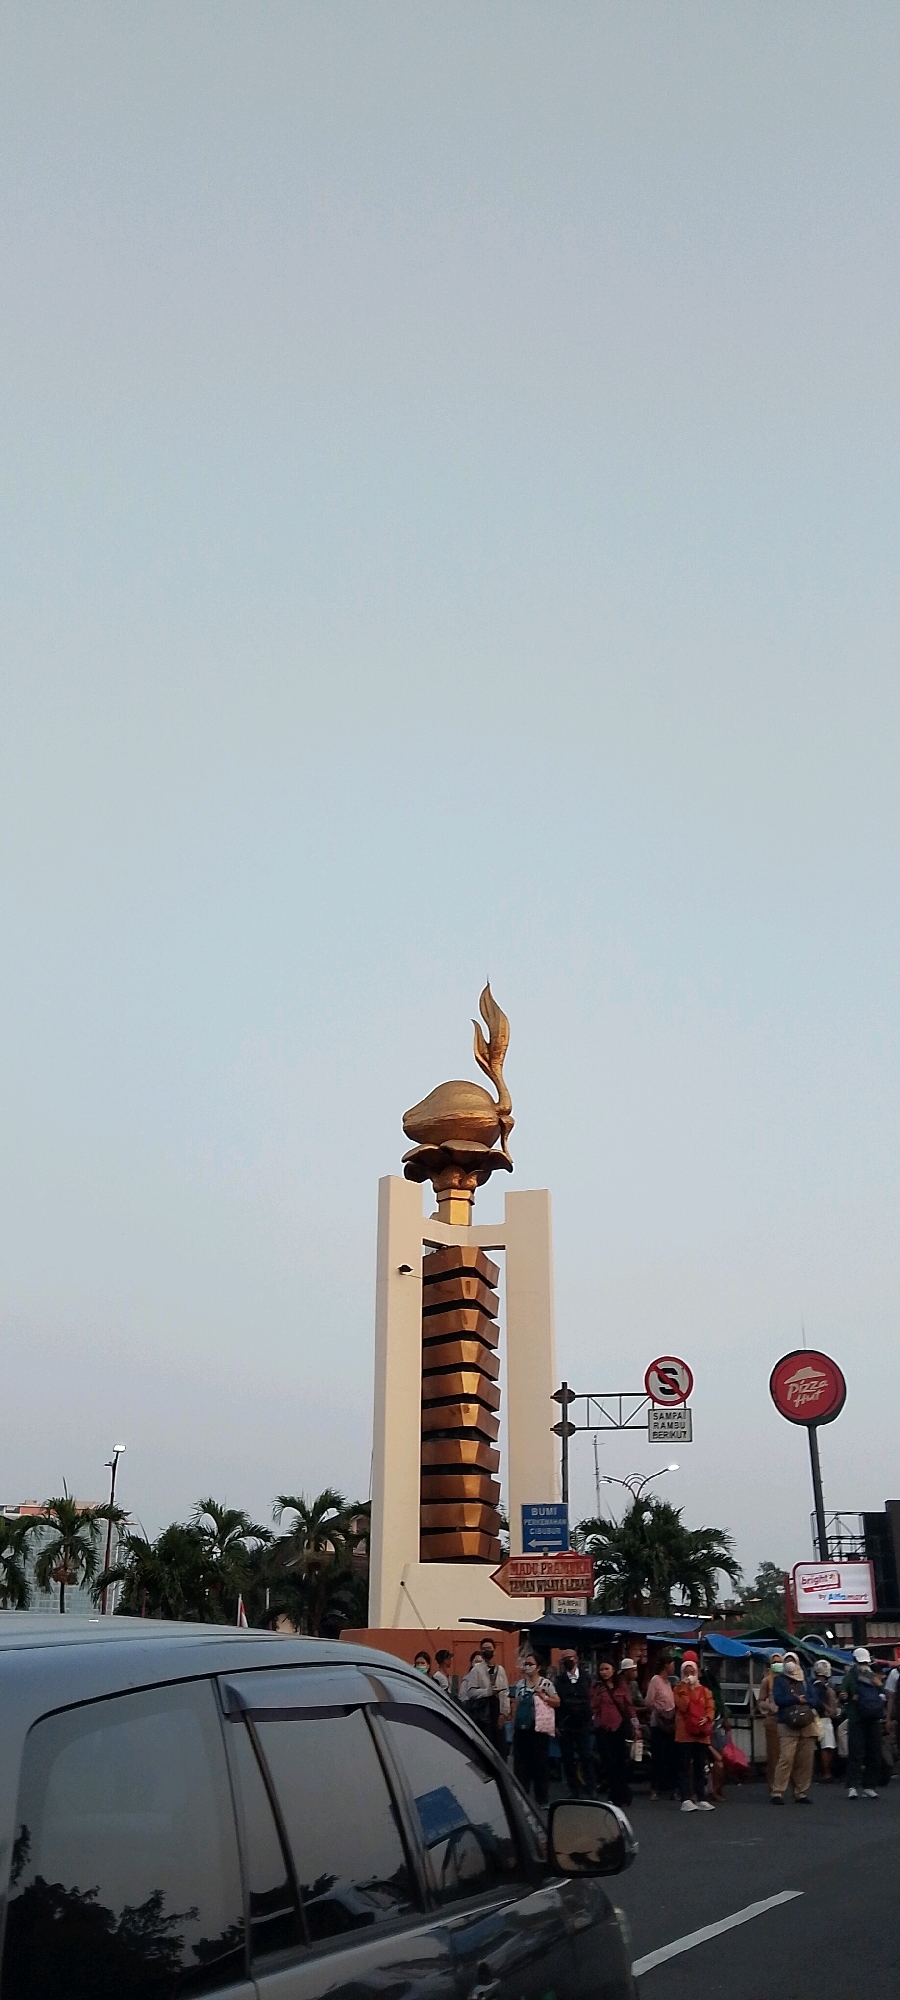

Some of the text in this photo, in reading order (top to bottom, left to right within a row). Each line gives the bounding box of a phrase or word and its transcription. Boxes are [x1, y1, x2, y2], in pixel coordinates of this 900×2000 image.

[787, 1380, 829, 1400] Pizza
[793, 1389, 825, 1408] Hut
[653, 1412, 687, 1420] SAMPAI
[653, 1431, 687, 1439] BERIKUT
[531, 1507, 558, 1516] BUMI
[802, 1574, 828, 1585] bright
